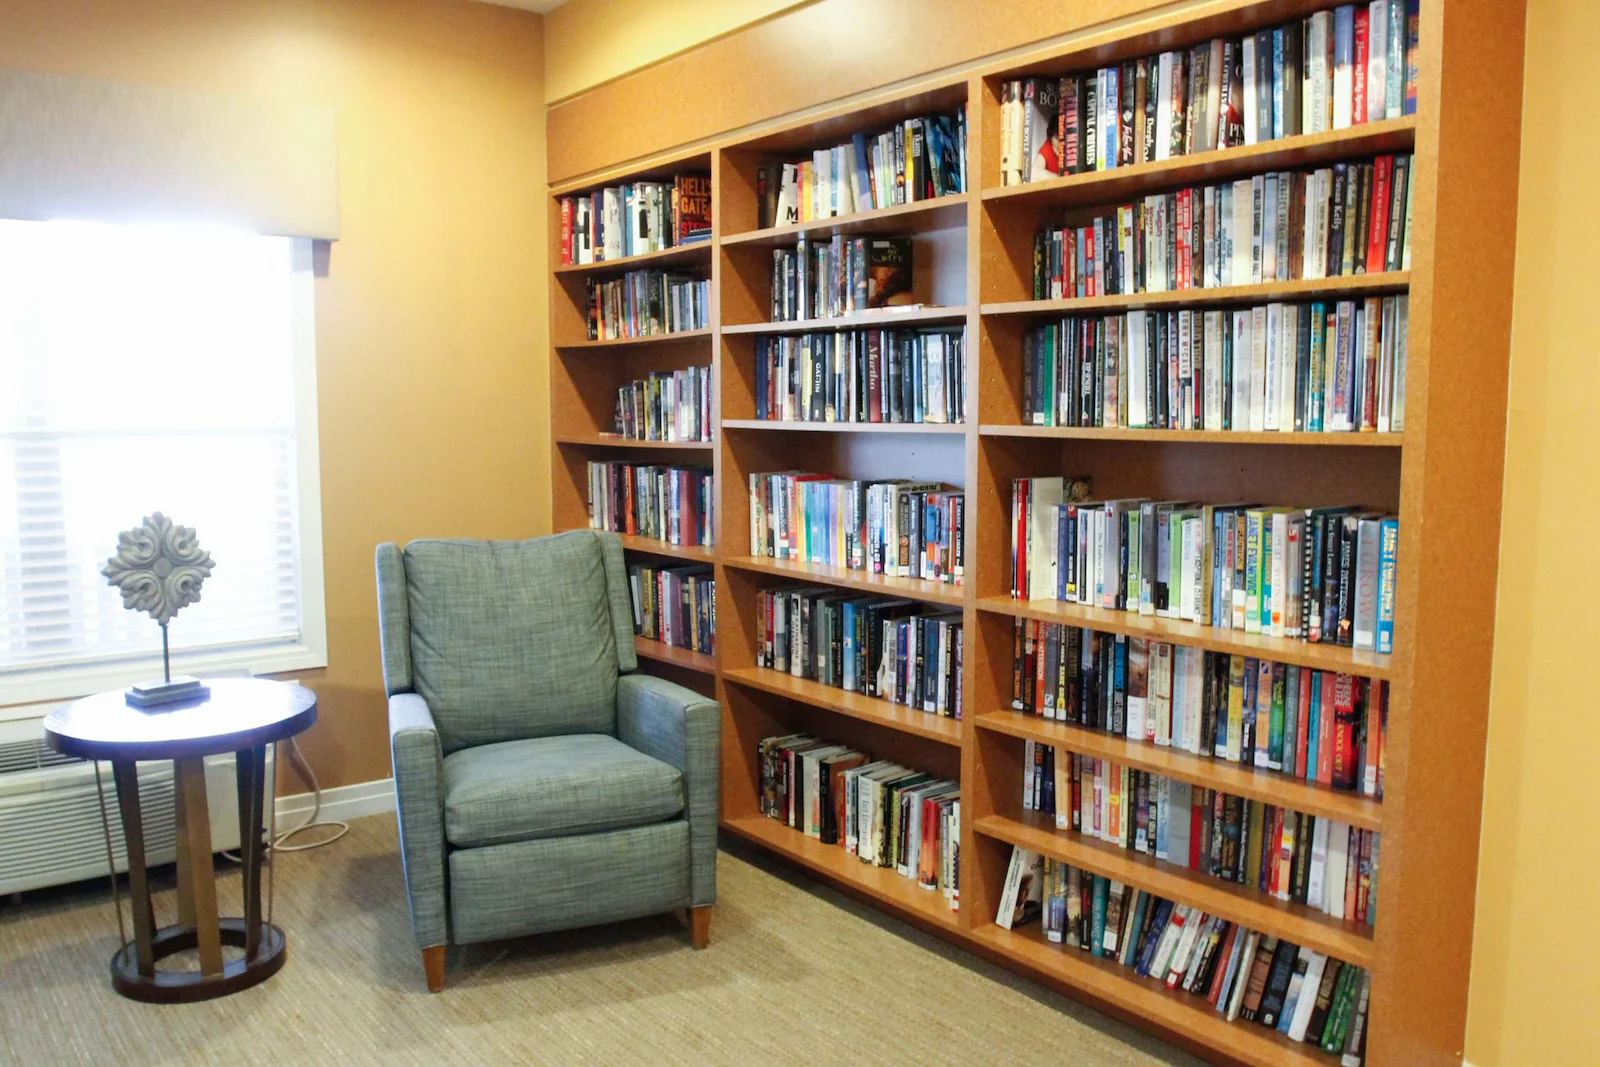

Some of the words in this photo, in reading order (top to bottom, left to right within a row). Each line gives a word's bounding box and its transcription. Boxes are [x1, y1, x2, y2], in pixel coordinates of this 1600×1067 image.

[1355, 40, 1364, 64] Home
[1354, 70, 1364, 93] Holly
[1066, 96, 1077, 128] PERRY
[1086, 91, 1097, 128] CAPITAL
[1106, 96, 1116, 126] CRAIS
[1355, 94, 1364, 122] Springs
[1086, 128, 1097, 165] CRIMES
[1145, 117, 1154, 148] Deeply
[1066, 133, 1077, 167] MASON
[681, 177, 711, 196] HELL'
[1334, 176, 1344, 203] Susan
[1332, 205, 1342, 231] Kelly
[869, 344, 878, 390] Martha
[1338, 338, 1348, 391] PATTERSON
[1248, 515, 1258, 546] JANET
[1384, 526, 1397, 559] JANET
[874, 553, 880, 562] GO
[1326, 553, 1334, 576] LAWYER
[1342, 540, 1351, 568] JAMES
[1247, 548, 1257, 596] EVANOVIC
[1359, 539, 1375, 618] TUROW
[1339, 569, 1350, 619] PATTERSON
[1381, 562, 1396, 621] EVANOVICH
[1037, 641, 1045, 681] PATTERSON
[1335, 723, 1345, 752] KNOCK
[1335, 753, 1343, 773] OUT
